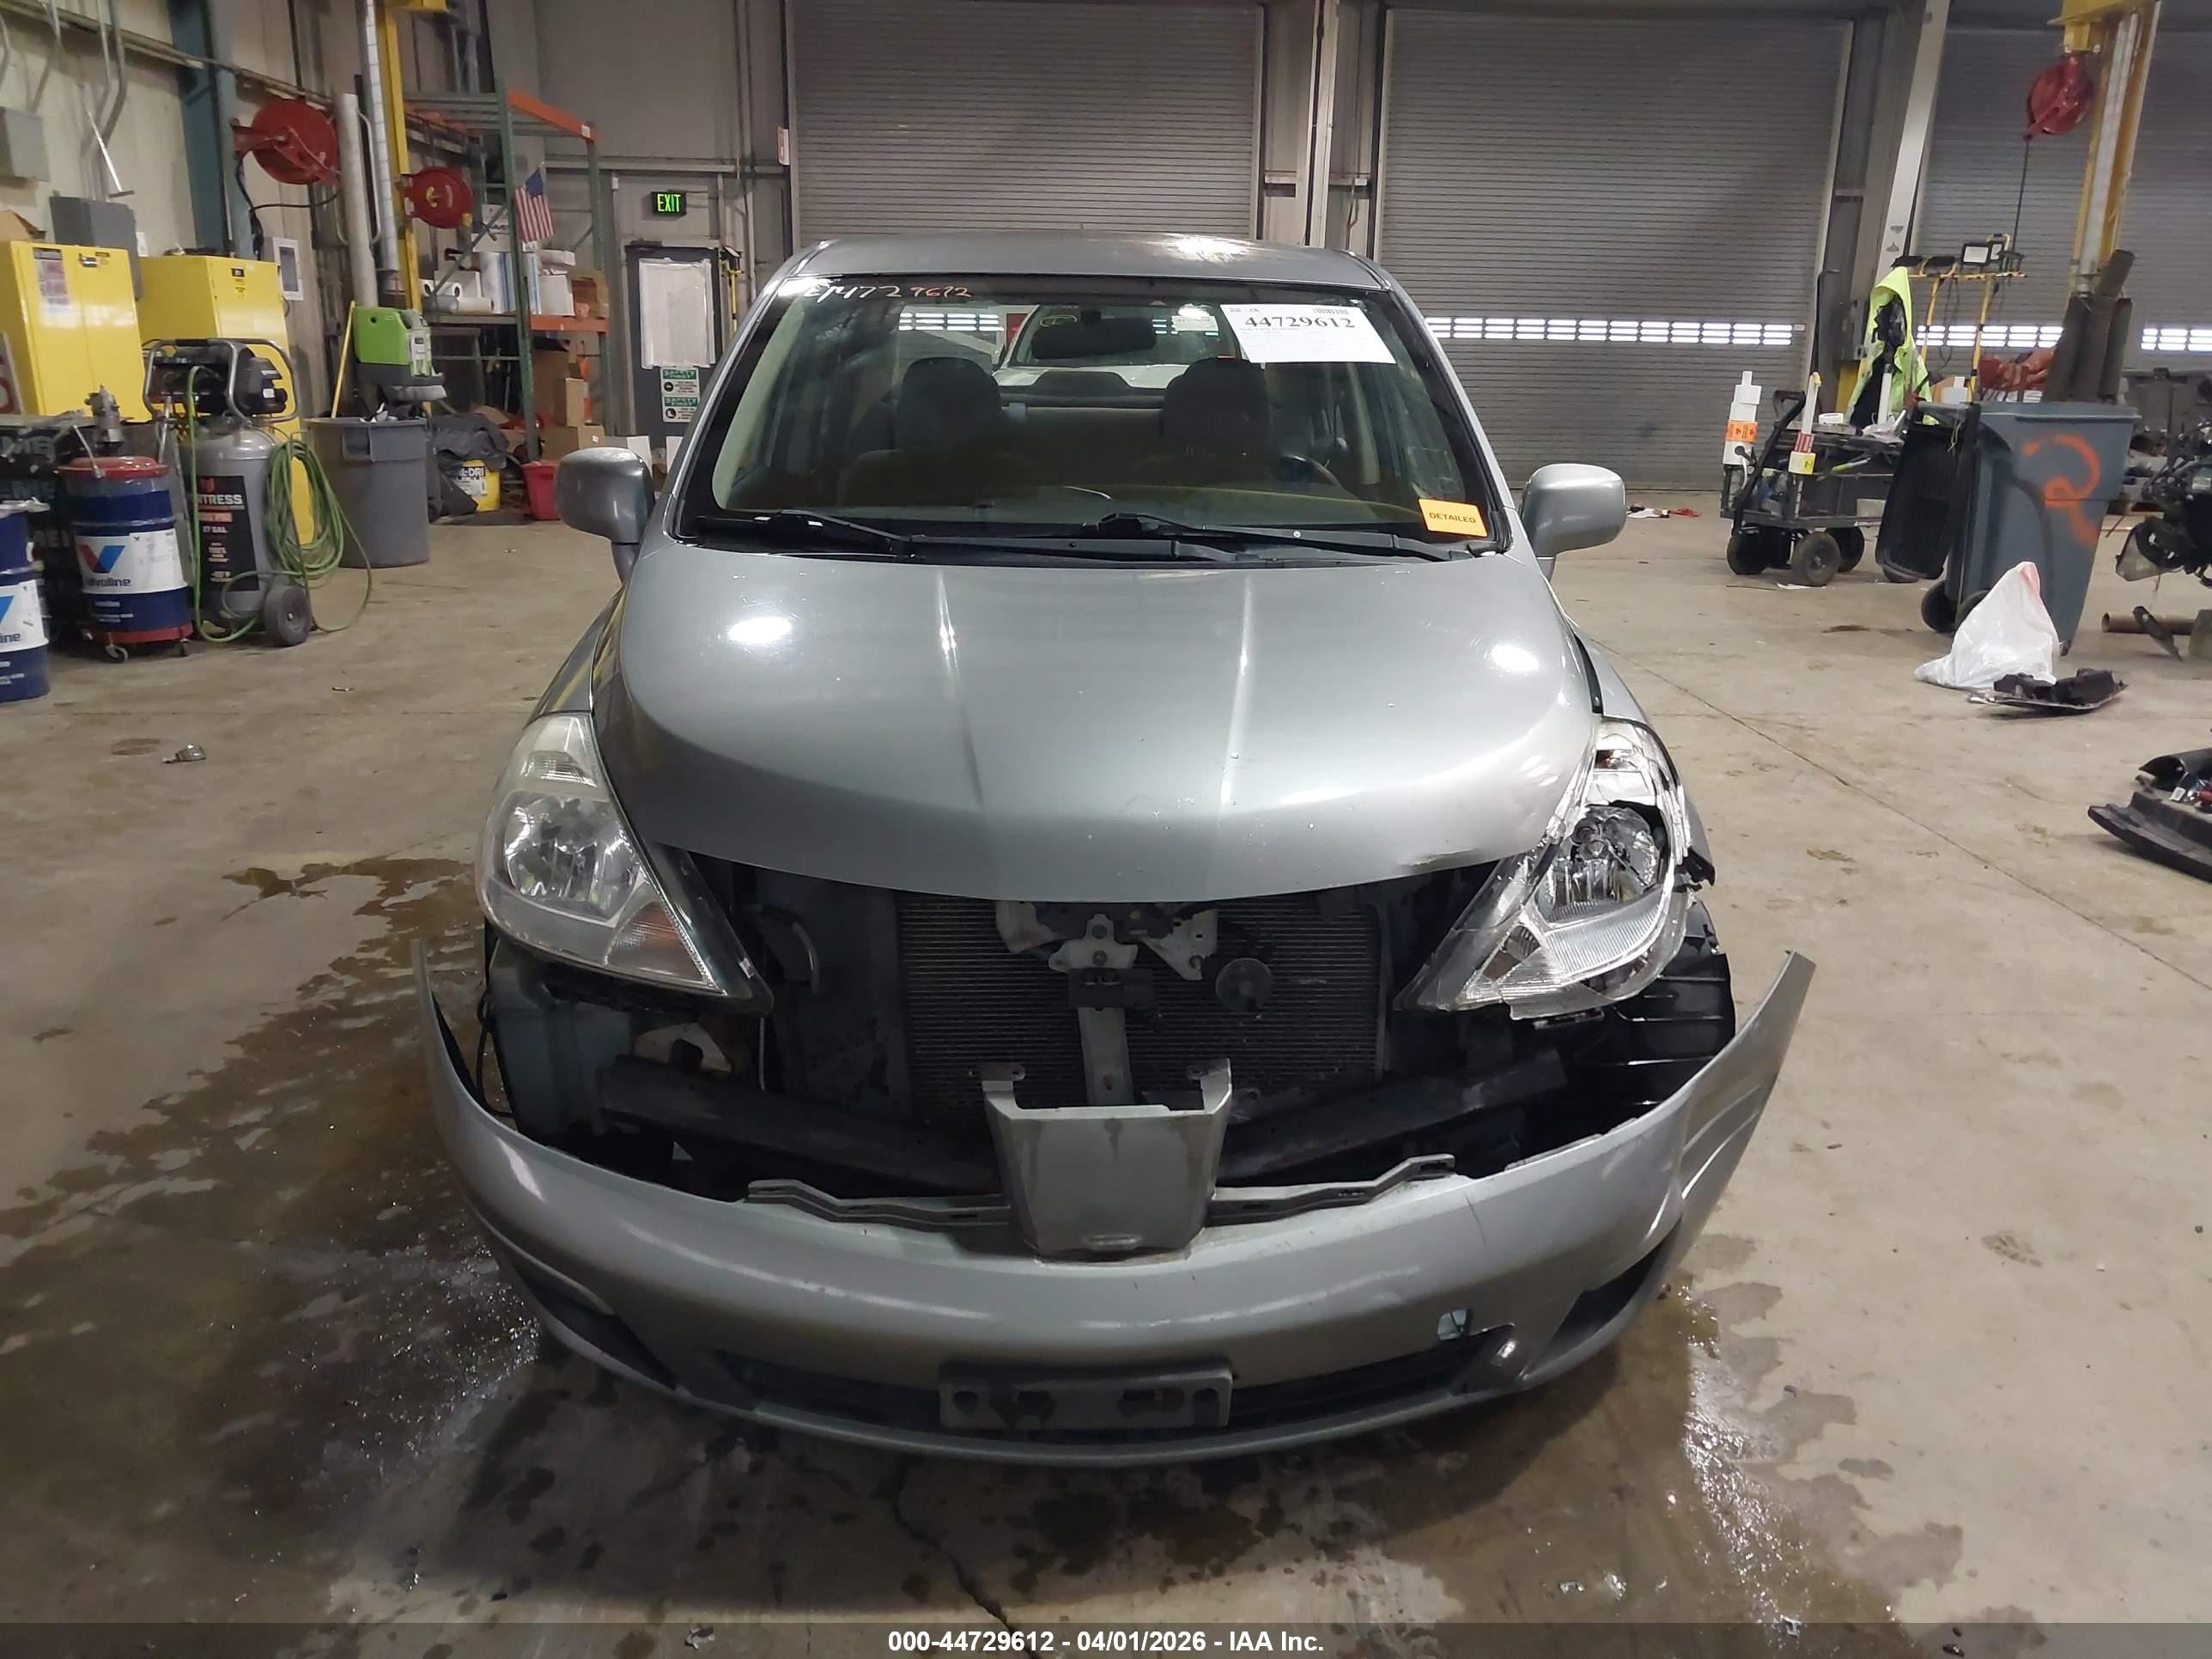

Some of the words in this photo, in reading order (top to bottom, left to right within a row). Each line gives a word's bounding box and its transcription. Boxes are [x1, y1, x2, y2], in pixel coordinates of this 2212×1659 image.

[657, 193, 682, 213] EXIT
[1245, 316, 1356, 328] 44729612
[198, 494, 243, 505] TRESS
[1429, 512, 1476, 524] DETAILED
[87, 577, 131, 587] voline
